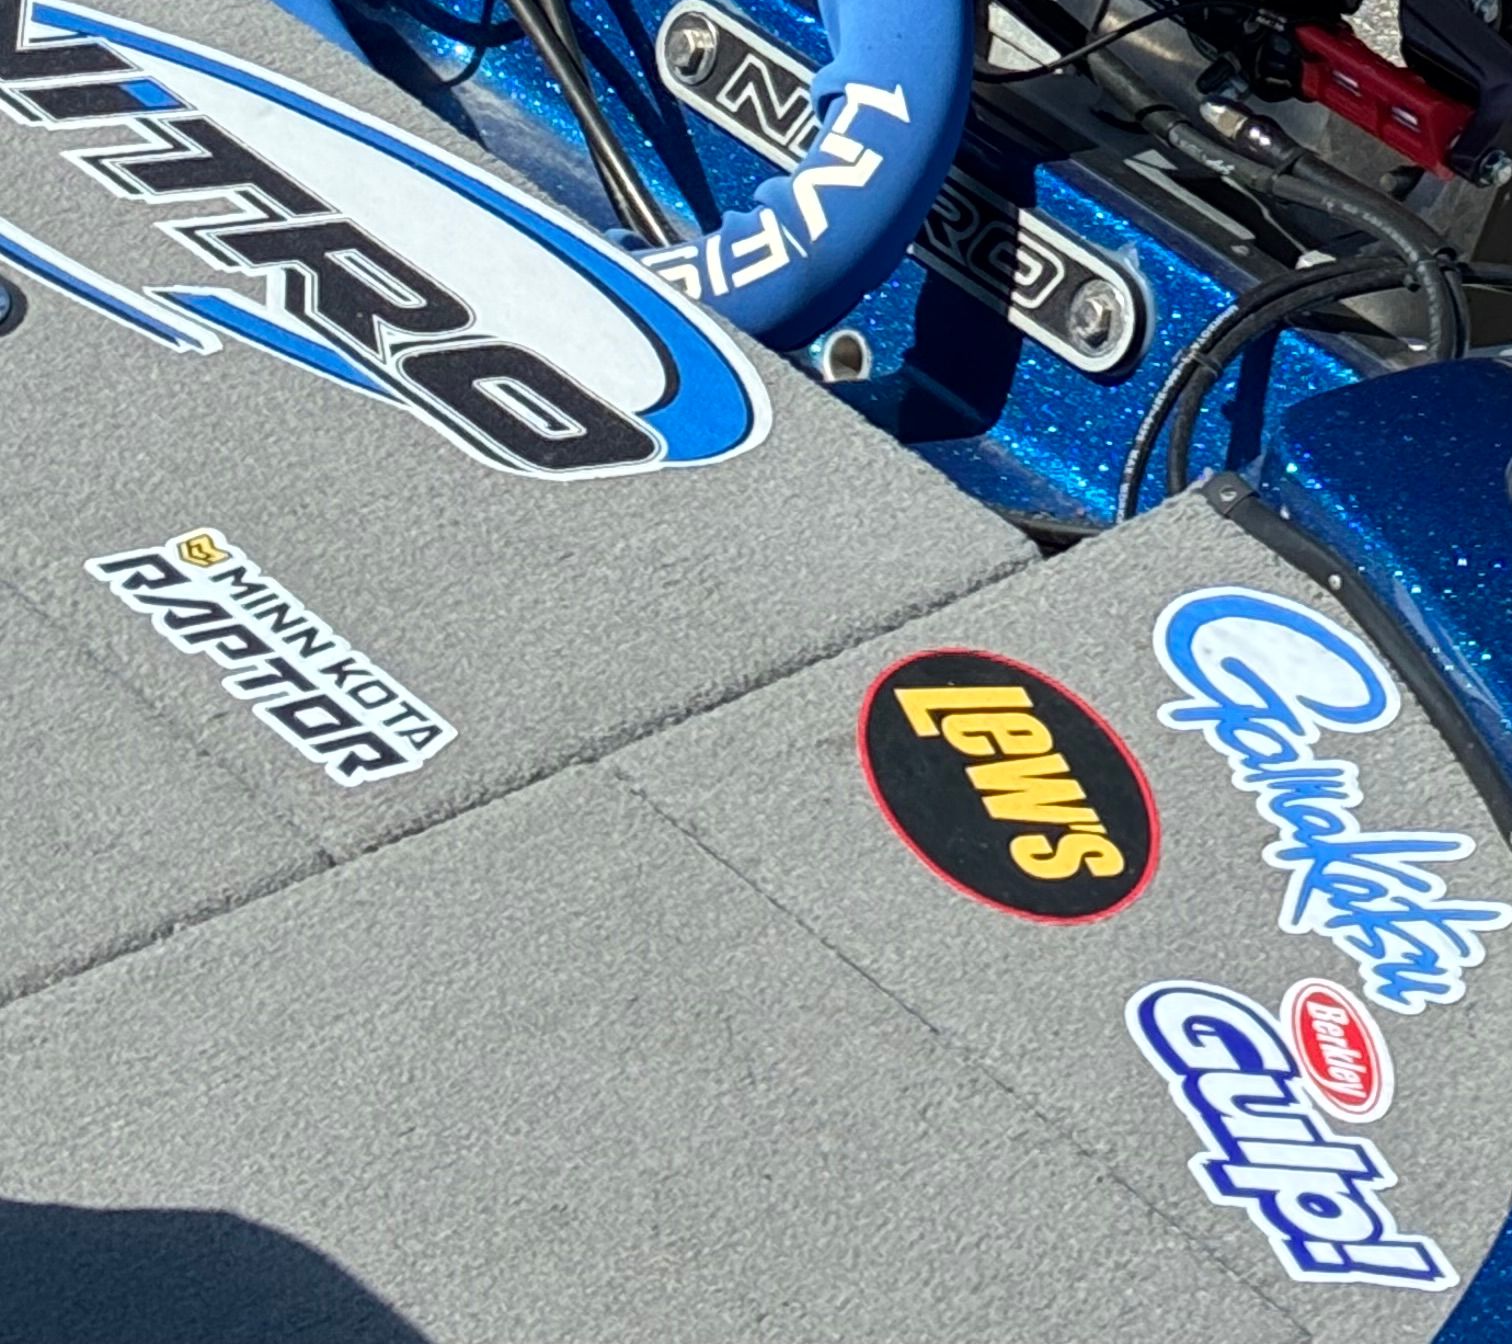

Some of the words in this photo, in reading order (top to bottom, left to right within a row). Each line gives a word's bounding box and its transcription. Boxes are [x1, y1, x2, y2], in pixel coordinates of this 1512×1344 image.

[98, 553, 409, 777] RAPTOR
[210, 566, 335, 659] MINN
[318, 658, 444, 751] KOTA
[1165, 594, 1502, 1006] Gamakatsu
[1137, 986, 1446, 1283] Gulp!
[1306, 1000, 1368, 1098] Berkley
